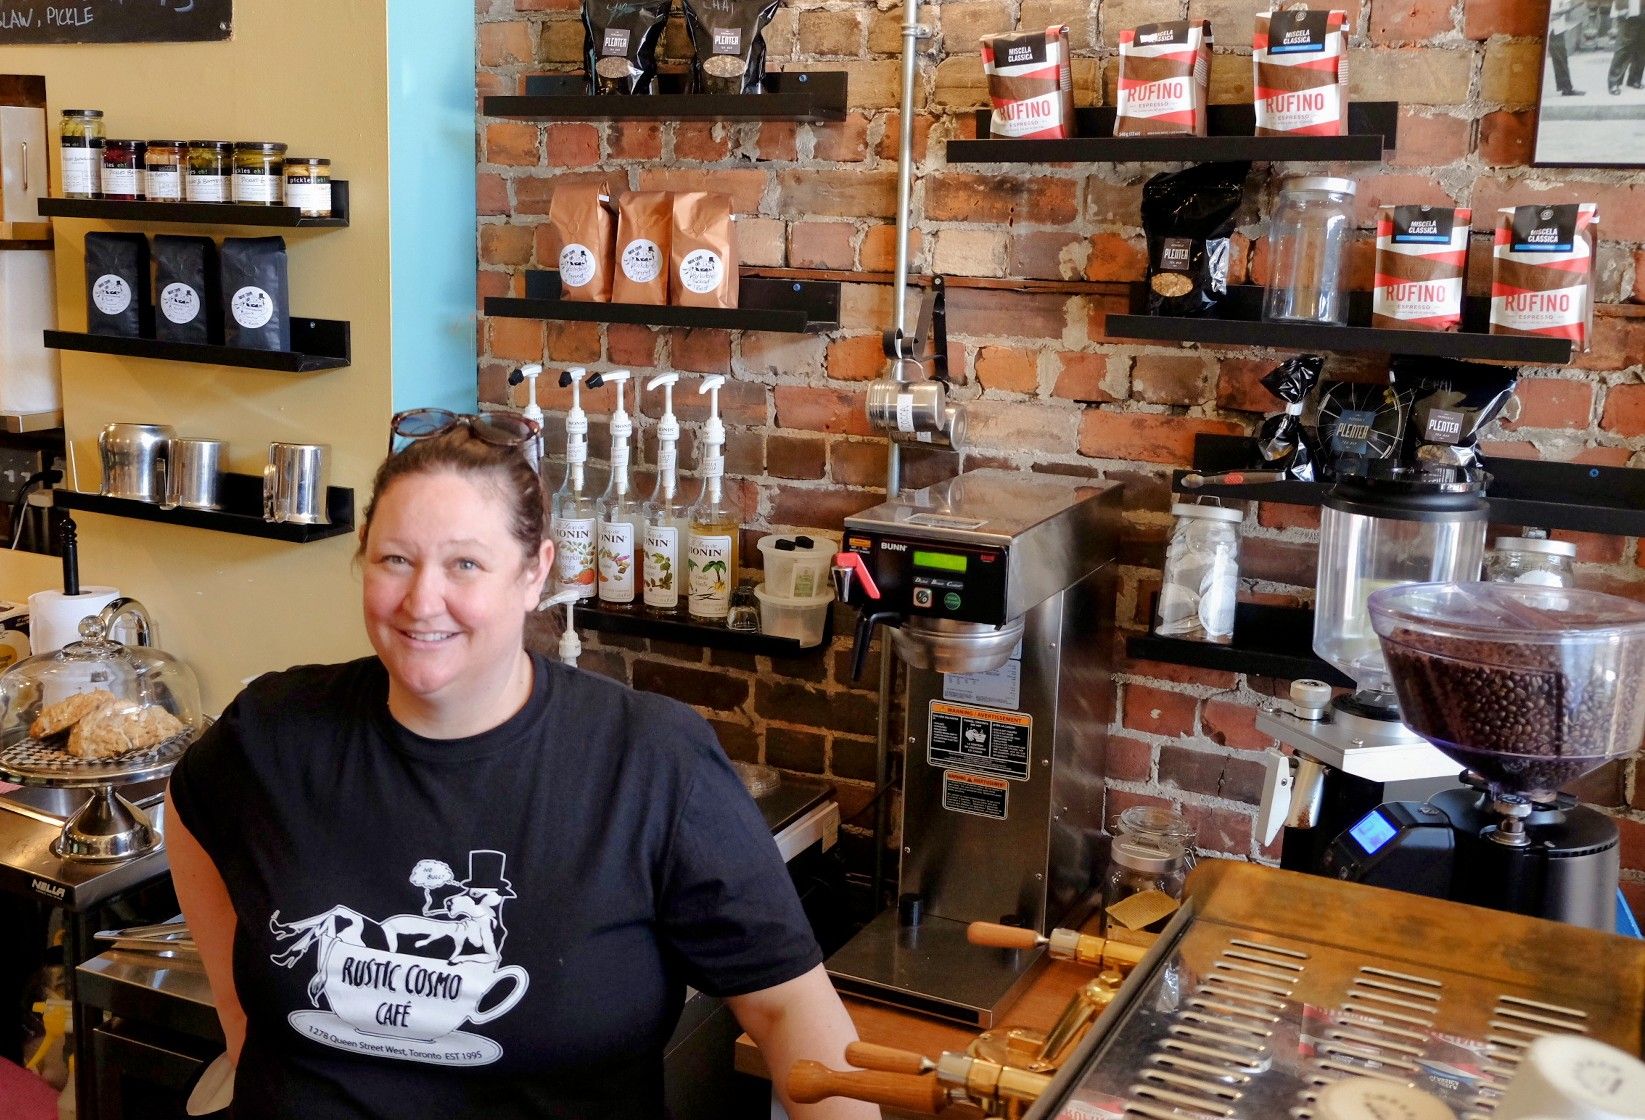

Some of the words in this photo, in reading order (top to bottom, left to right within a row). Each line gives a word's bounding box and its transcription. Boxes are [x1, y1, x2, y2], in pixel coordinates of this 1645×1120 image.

[46, 7, 94, 26] PICKLE
[1283, 36, 1311, 45] CLASSICA
[1285, 29, 1310, 37] MISCELA
[1007, 53, 1033, 63] CLASSICA
[1008, 46, 1032, 55] MISCELA
[1127, 82, 1183, 102] RUFINO
[1000, 100, 1051, 121] RUFINO
[1265, 93, 1325, 113] RUFINO
[1527, 235, 1559, 243] CLASSICA
[1530, 228, 1558, 236] MISCELA
[1385, 284, 1446, 302] RUFINO
[1504, 294, 1570, 312] RUFINO
[947, 707, 973, 717] WARNING
[341, 956, 401, 992] RUSTIC
[405, 964, 463, 1001] COSMO
[375, 1000, 412, 1028] CAFÉ
[308, 1025, 329, 1040] 1278
[330, 1034, 358, 1048] Queen
[359, 1041, 384, 1052] Street
[409, 1049, 442, 1060] Toronto
[445, 1052, 460, 1061] EST
[462, 1051, 483, 1060] 1995
